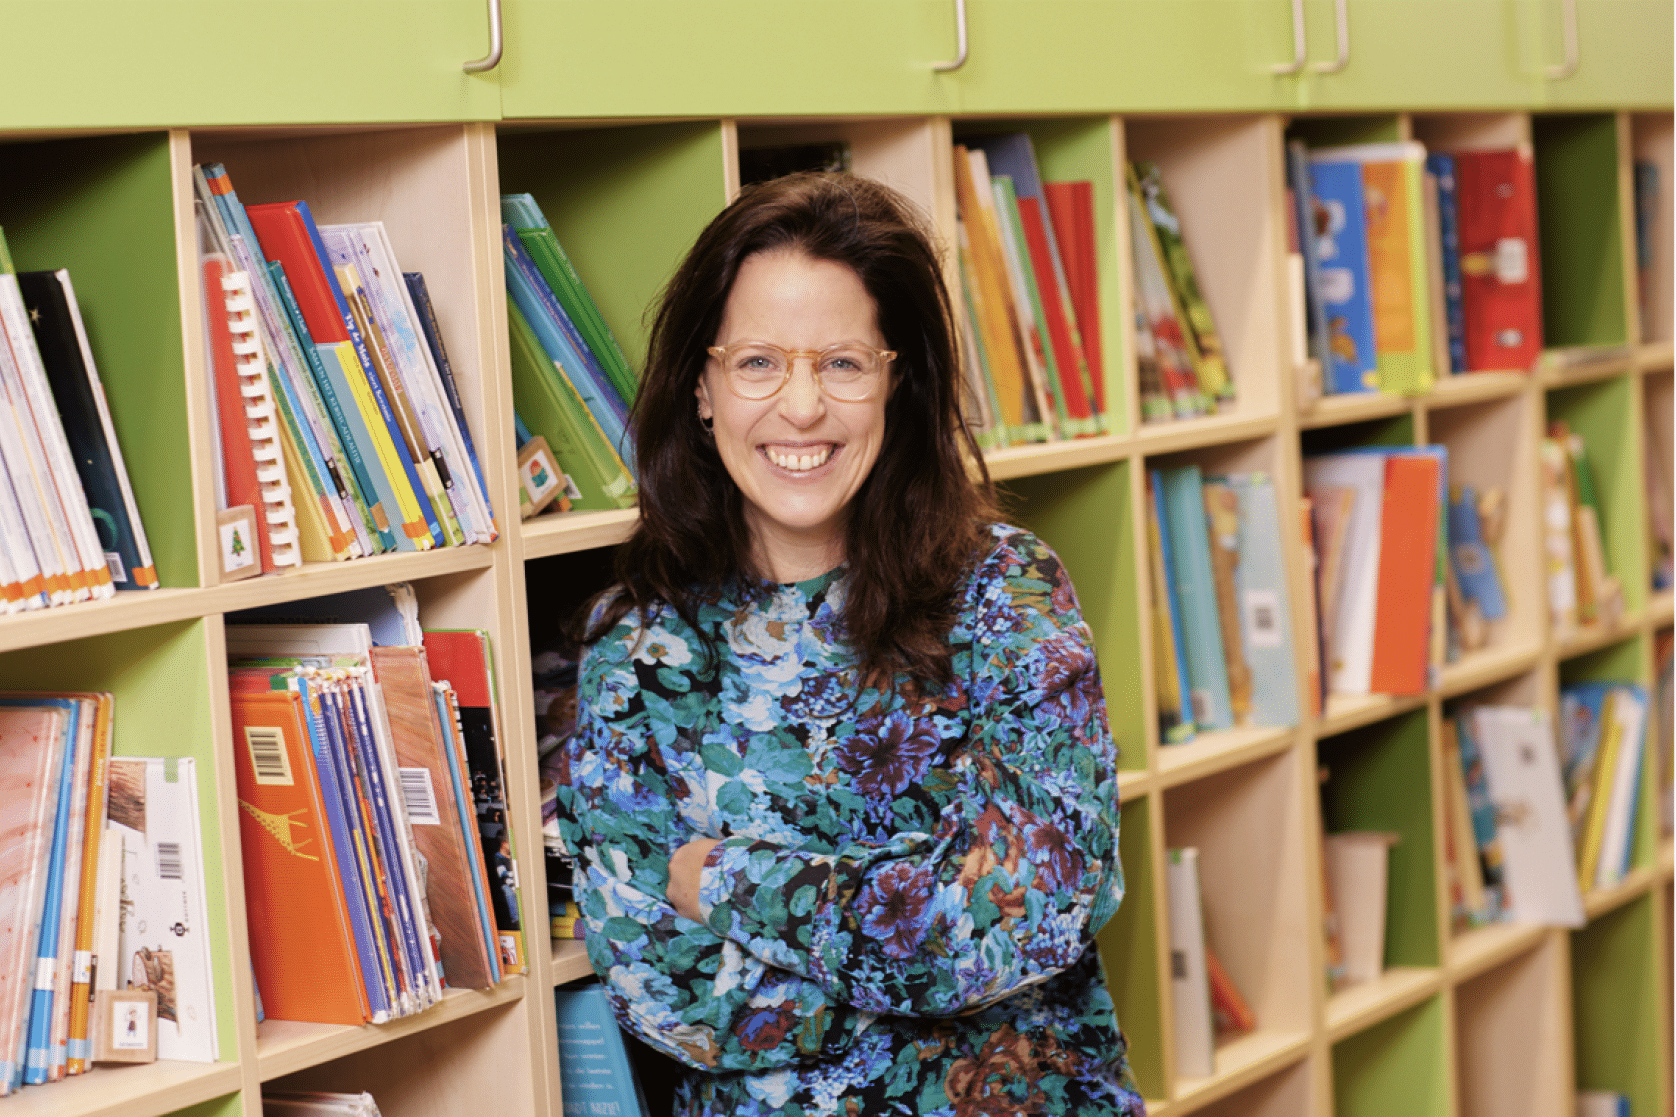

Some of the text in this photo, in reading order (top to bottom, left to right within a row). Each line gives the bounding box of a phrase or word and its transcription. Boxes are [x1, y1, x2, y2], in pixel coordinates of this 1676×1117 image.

[344, 314, 355, 331] Tip
[351, 331, 360, 342] de
[357, 344, 371, 368] Muis
